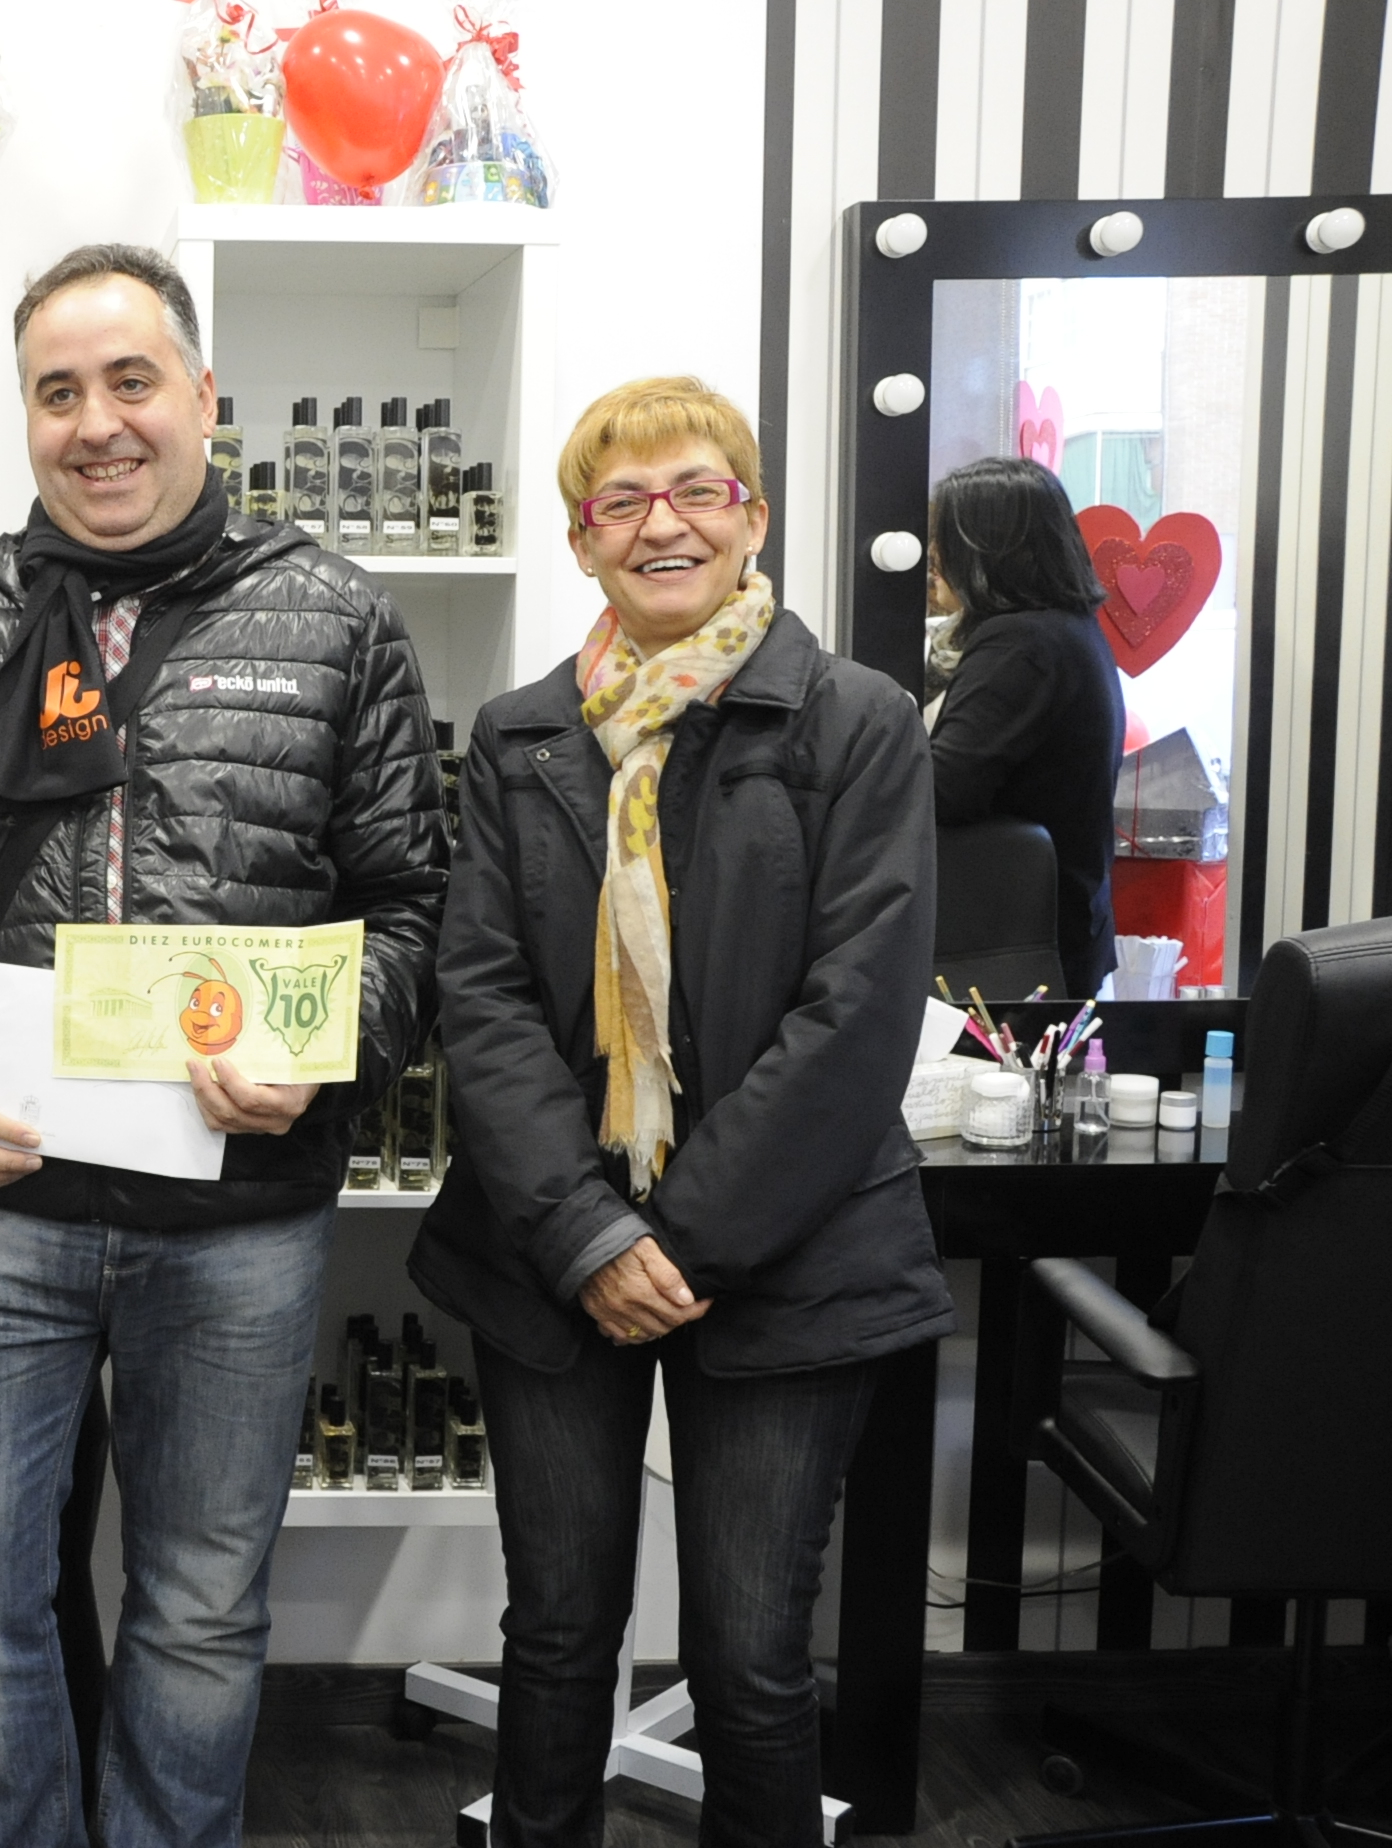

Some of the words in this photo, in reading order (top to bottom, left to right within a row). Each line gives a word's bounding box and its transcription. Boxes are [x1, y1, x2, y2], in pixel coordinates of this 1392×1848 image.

[130, 934, 170, 947] DIEZ
[182, 935, 306, 949] EUROCOMERZ
[283, 976, 318, 990] VALE
[279, 992, 318, 1029] 10
